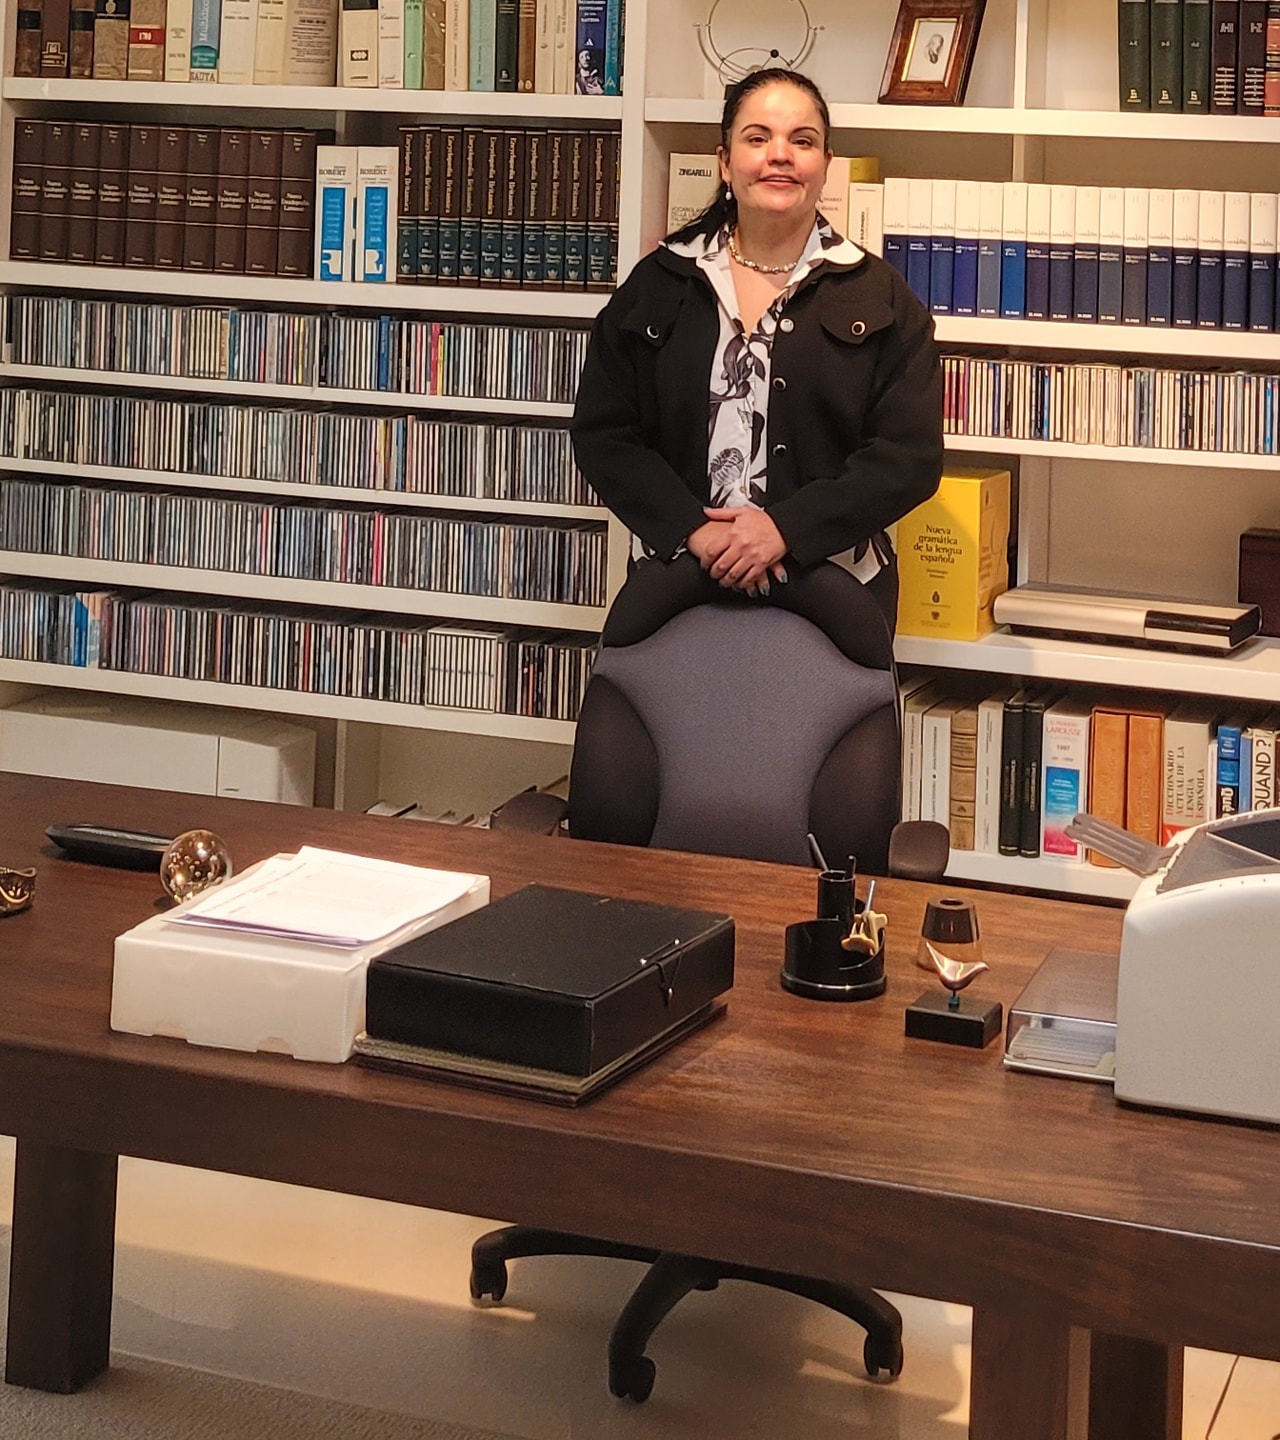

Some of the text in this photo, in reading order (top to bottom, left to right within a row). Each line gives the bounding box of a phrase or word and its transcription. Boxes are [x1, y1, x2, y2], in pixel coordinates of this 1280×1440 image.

[319, 168, 346, 176] ROBERT
[360, 168, 387, 176] ROBERT
[678, 168, 712, 177] ZINGARELLI
[926, 525, 951, 535] Nueva
[919, 534, 958, 545] gramática
[935, 545, 962, 555] lengua
[920, 554, 955, 564] española
[1046, 727, 1080, 736] LAROUSSE
[1255, 739, 1271, 812] QUAND ?
[1166, 750, 1175, 816] DICCIONARIO
[1176, 777, 1184, 815] ACTUAL
[1186, 778, 1194, 817] LENGUA
[1196, 769, 1204, 818] ESPAÑOLA
